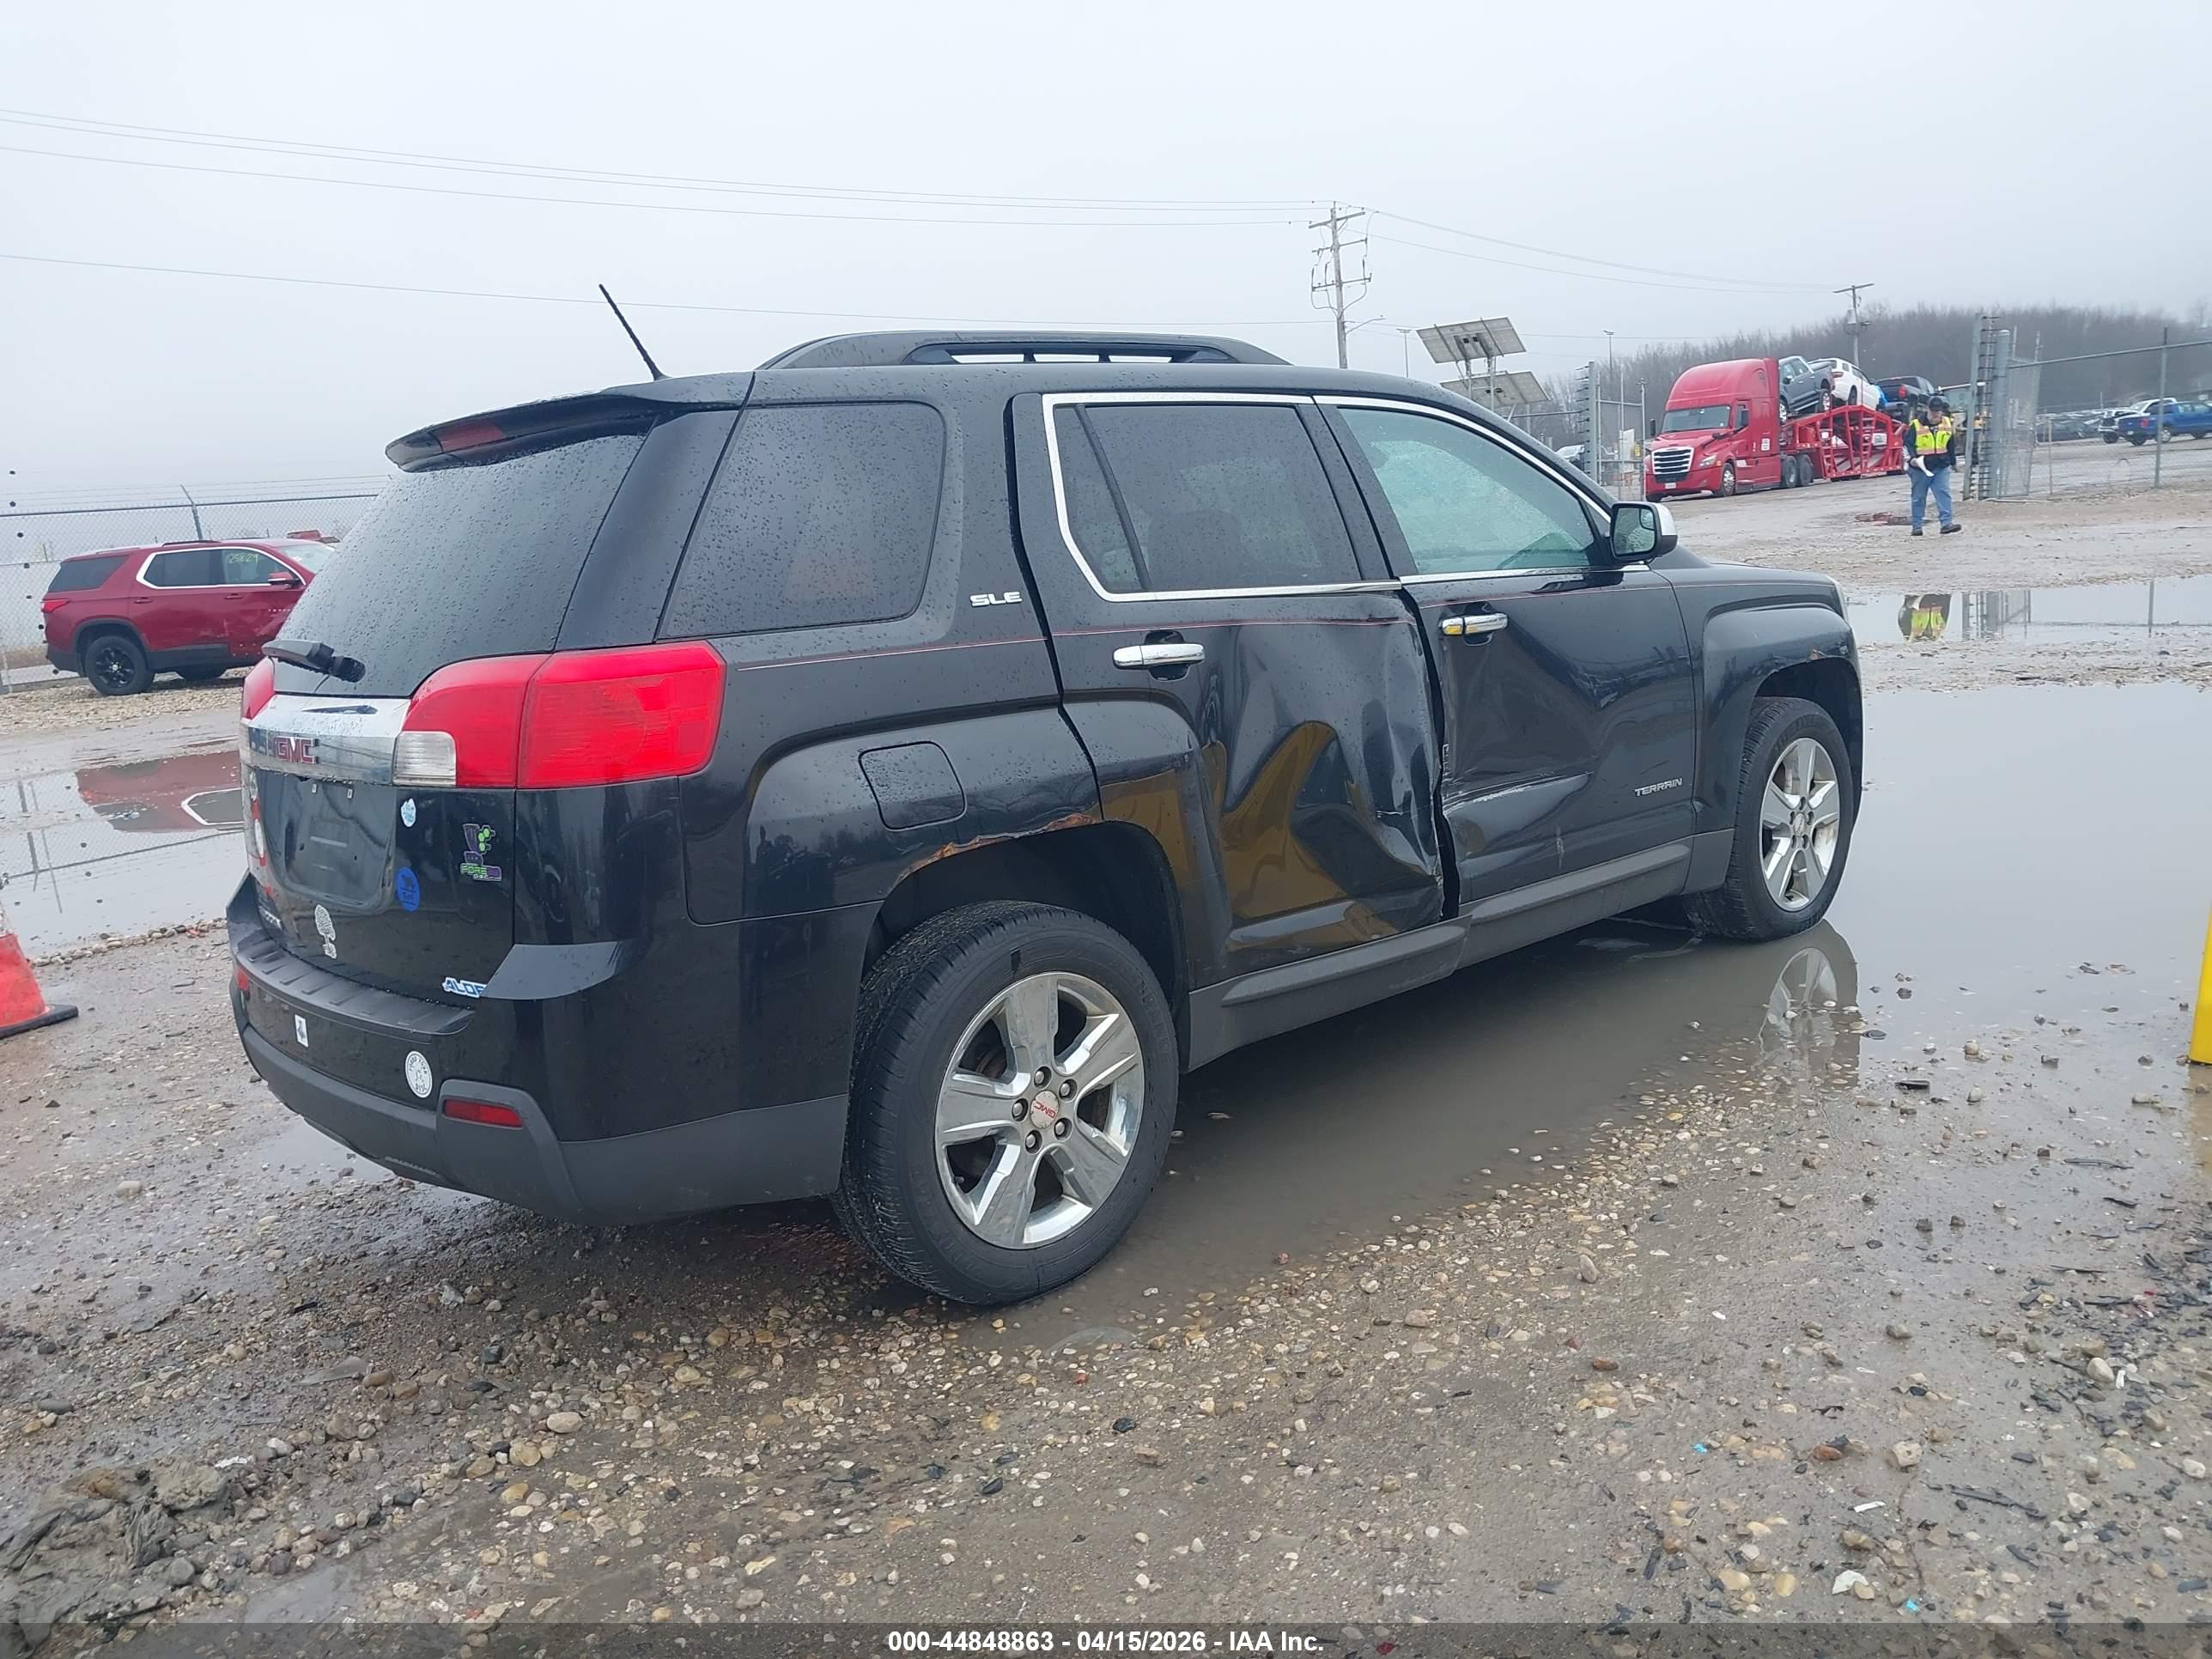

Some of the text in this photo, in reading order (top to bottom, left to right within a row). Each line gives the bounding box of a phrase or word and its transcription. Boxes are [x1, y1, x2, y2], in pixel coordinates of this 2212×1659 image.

[969, 592, 1023, 607] SLE
[274, 736, 317, 764] GMC
[1634, 777, 1683, 797] TERRAIN
[1034, 1101, 1056, 1118] GMC
